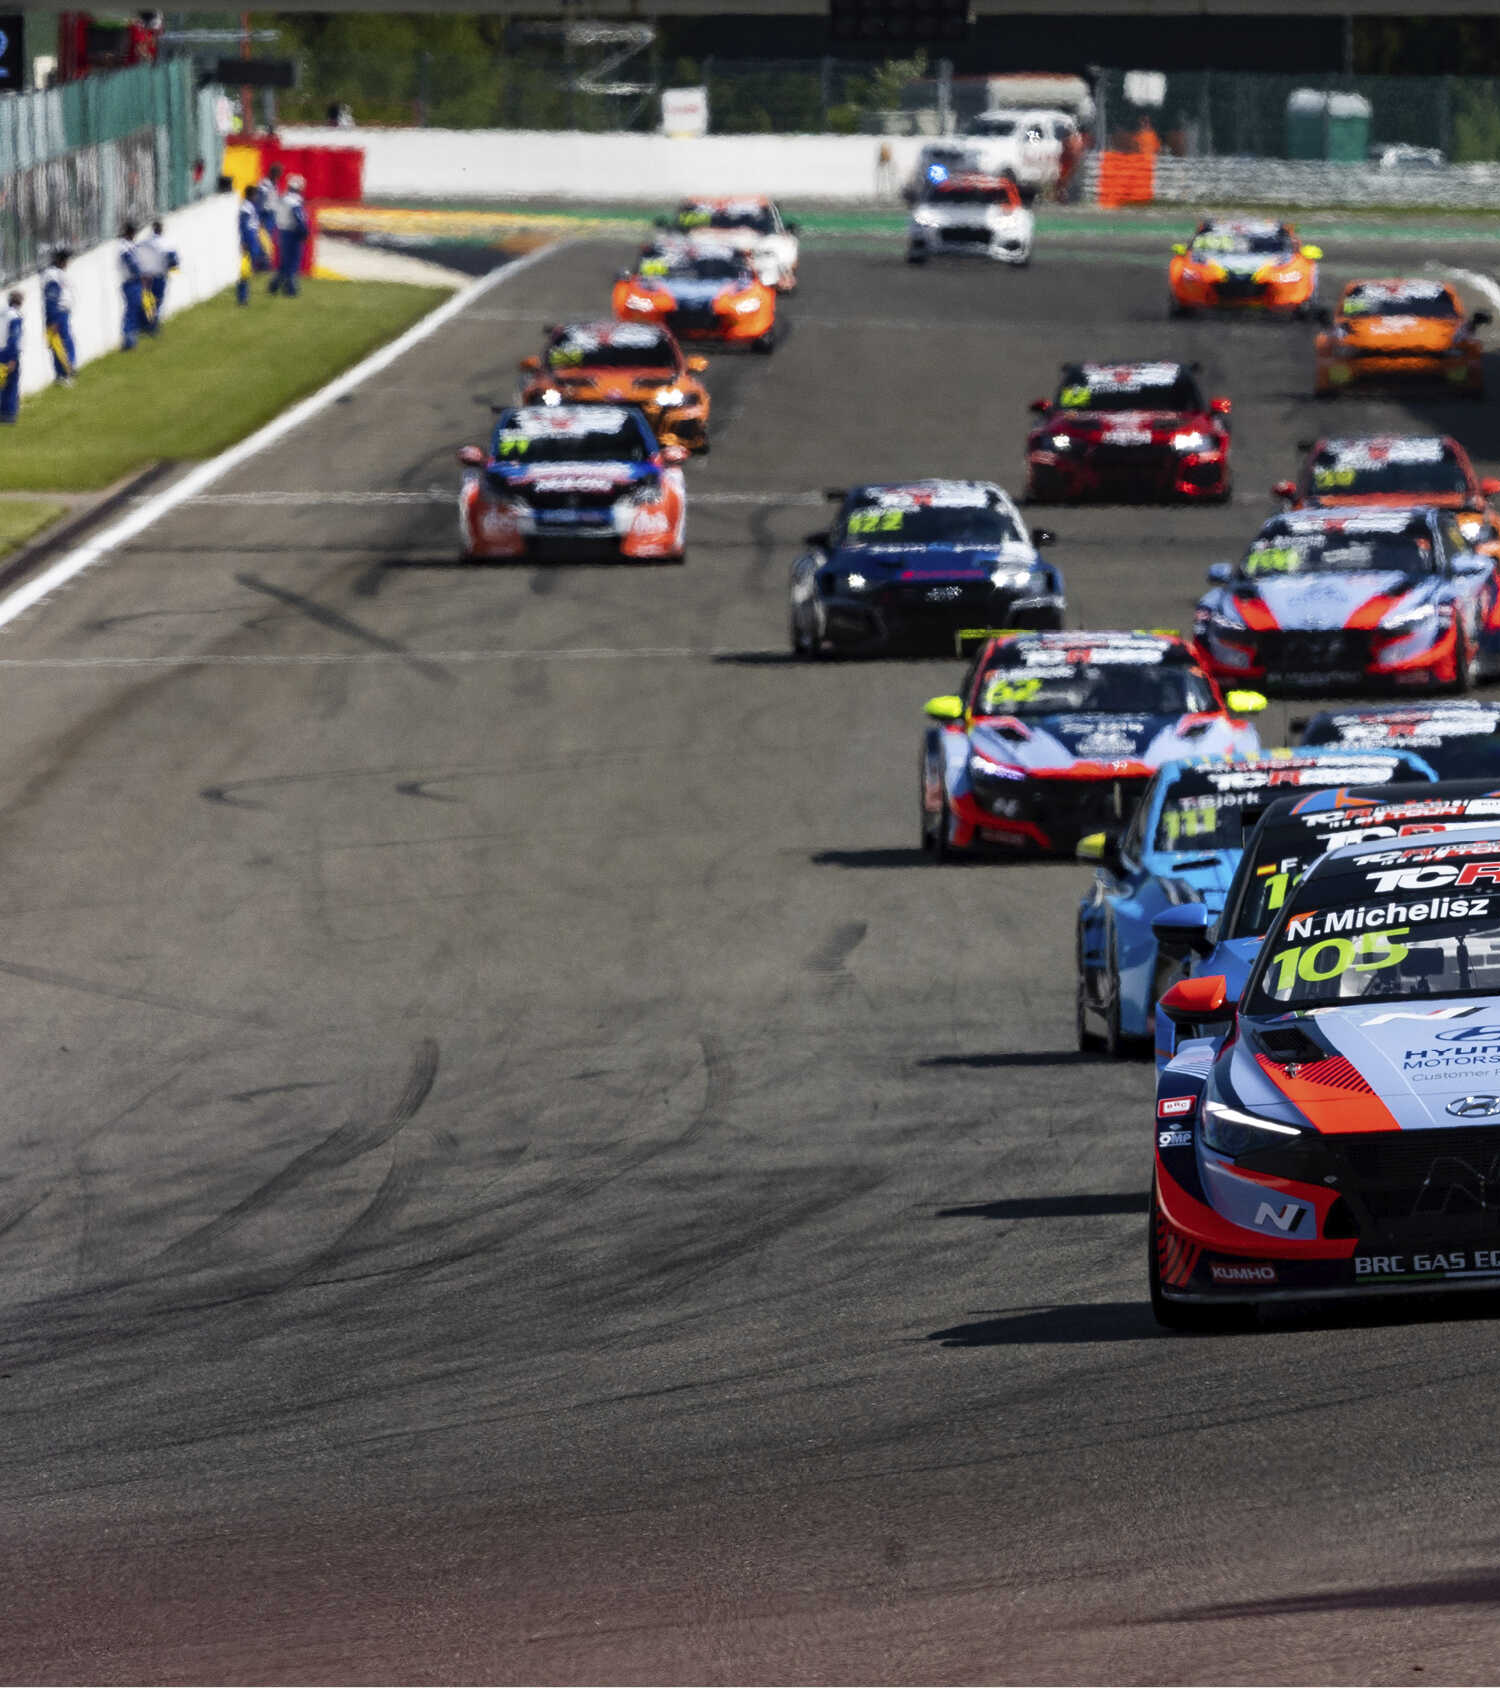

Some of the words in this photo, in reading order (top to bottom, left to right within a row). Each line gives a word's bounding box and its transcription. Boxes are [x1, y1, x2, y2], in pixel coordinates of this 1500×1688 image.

[1287, 897, 1490, 942] N.Michelisz
[1272, 927, 1411, 991] 105
[1411, 1070, 1492, 1083] Customer
[1159, 1132, 1192, 1145] OMP
[1354, 1255, 1406, 1275] BRC
[1413, 1252, 1466, 1271] GAS
[1211, 1266, 1276, 1280] KUMHO
